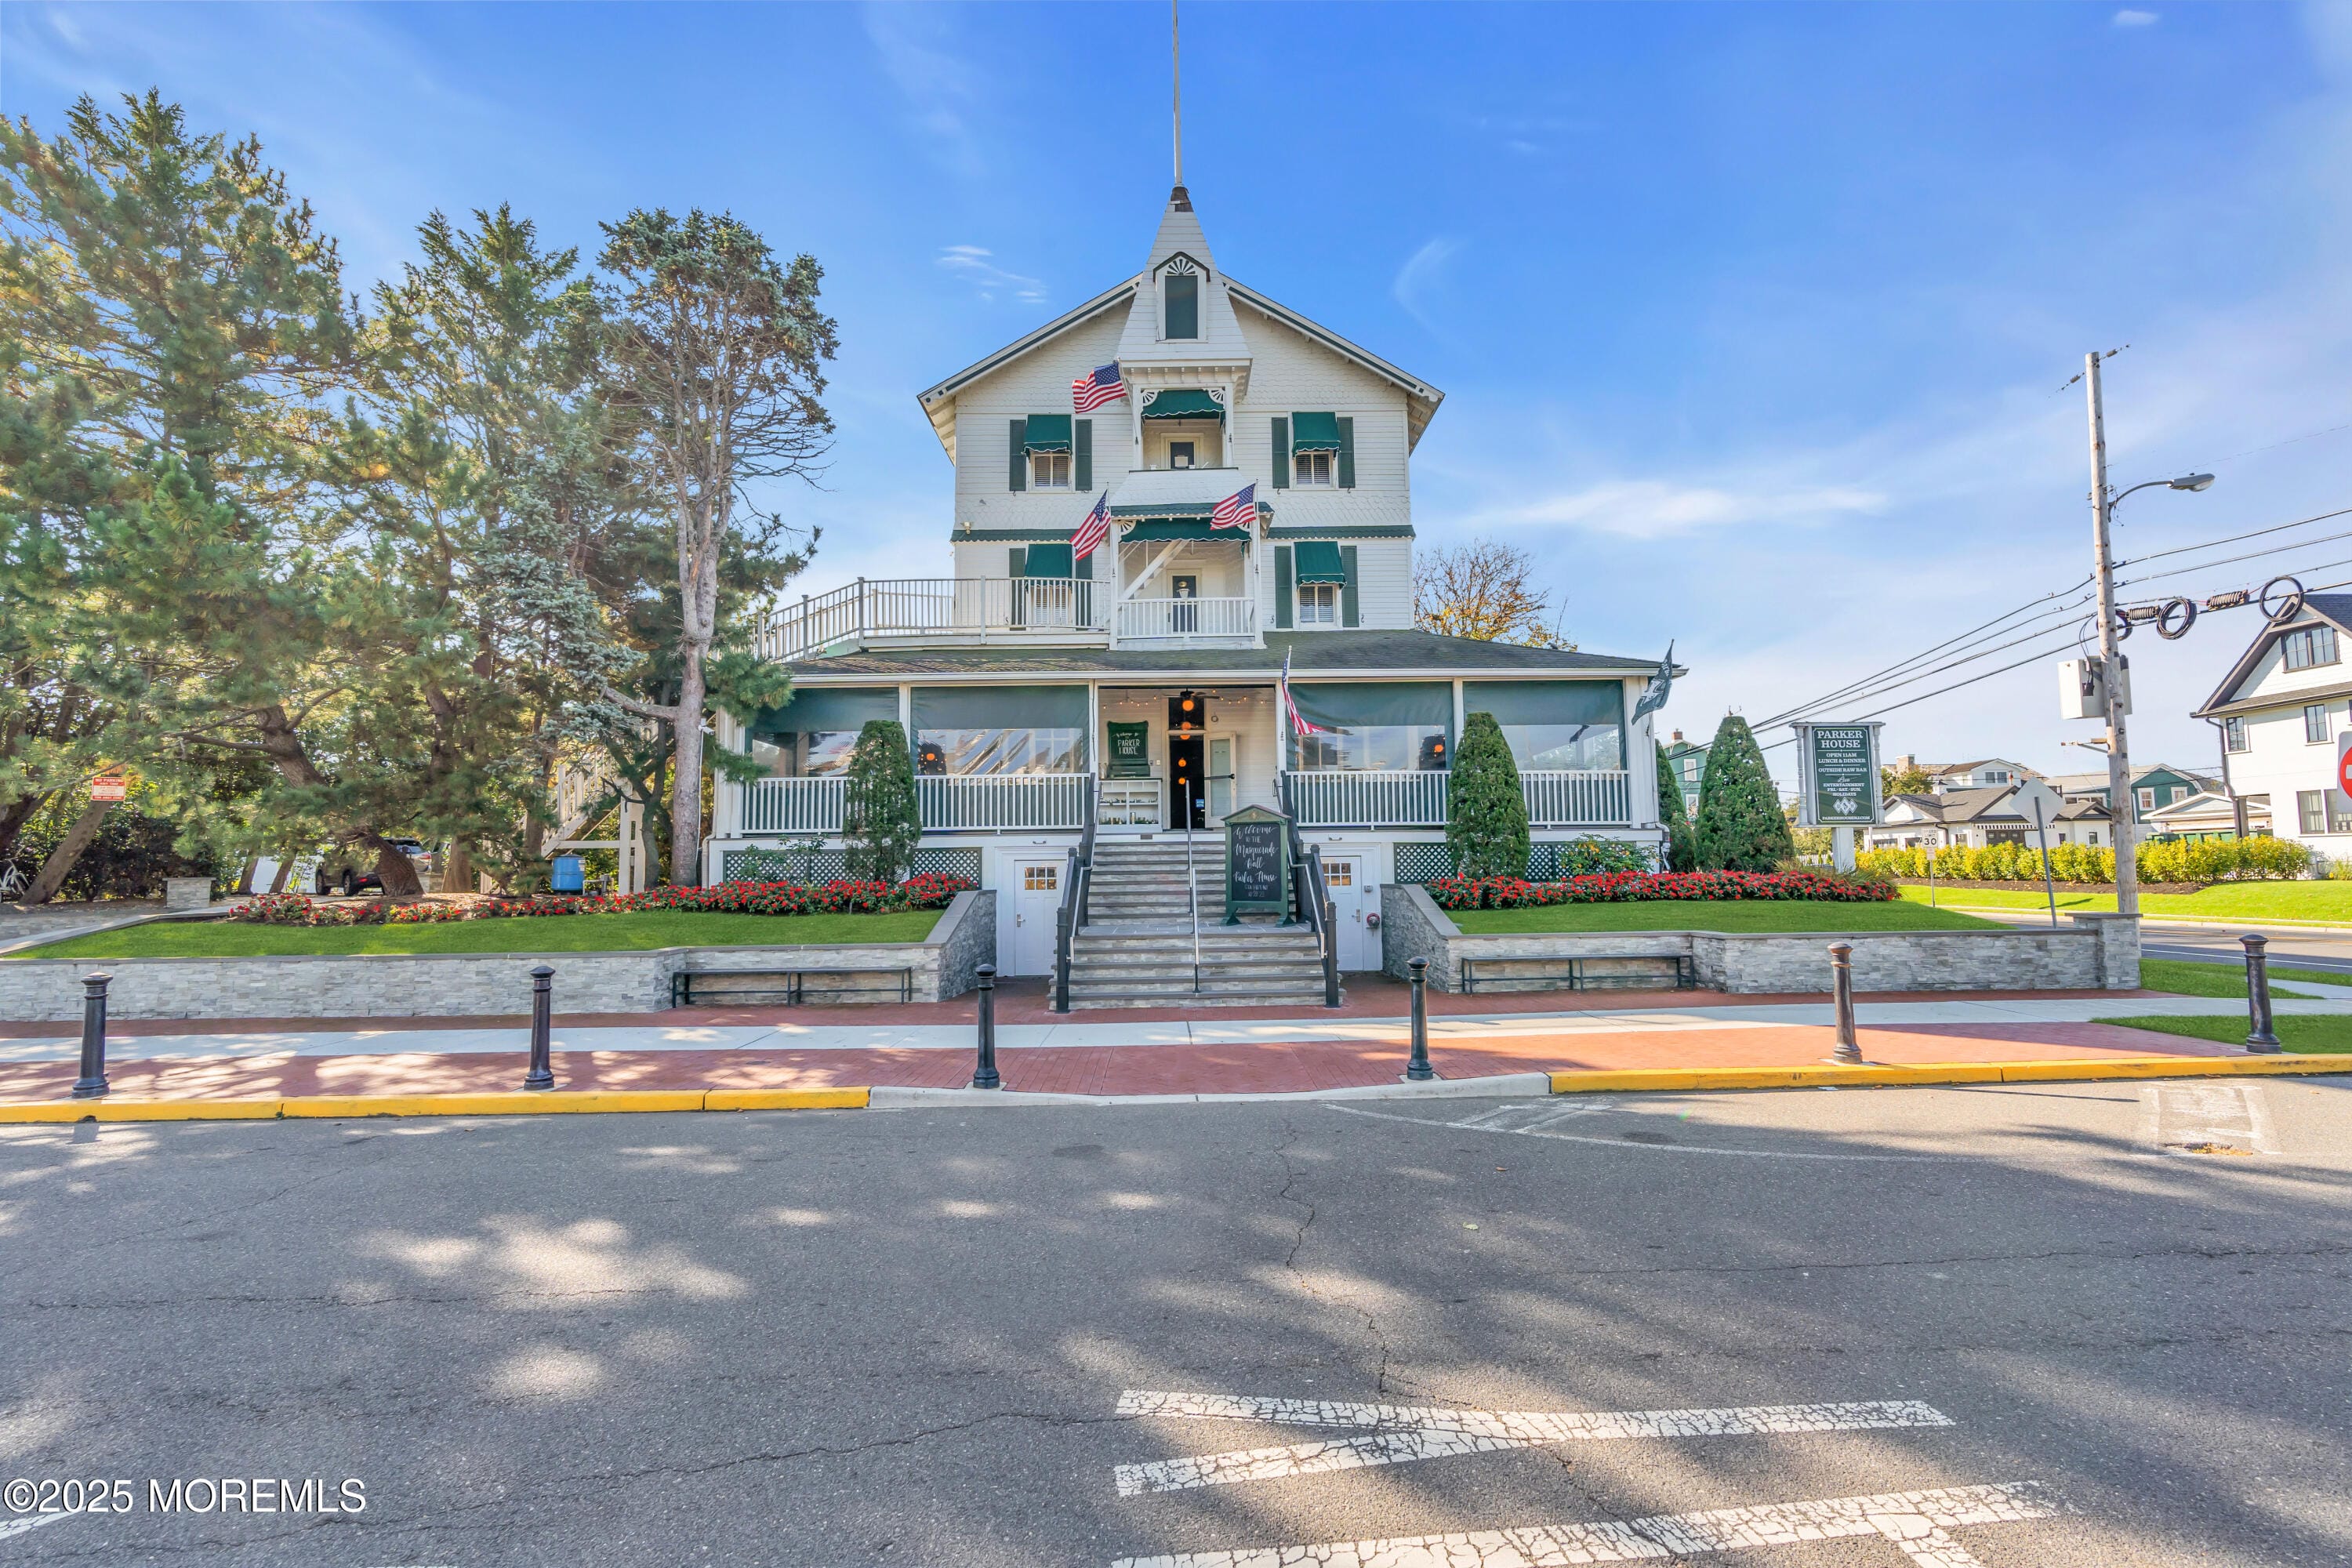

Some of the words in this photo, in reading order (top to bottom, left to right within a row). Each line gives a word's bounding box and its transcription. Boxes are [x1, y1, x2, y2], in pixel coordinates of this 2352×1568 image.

[1817, 730, 1864, 739] PARKER
[1119, 746, 1138, 755] HOUSE
[1233, 825, 1278, 839] Welcome
[1235, 842, 1279, 861] Masquerade
[1246, 857, 1265, 869] Ball
